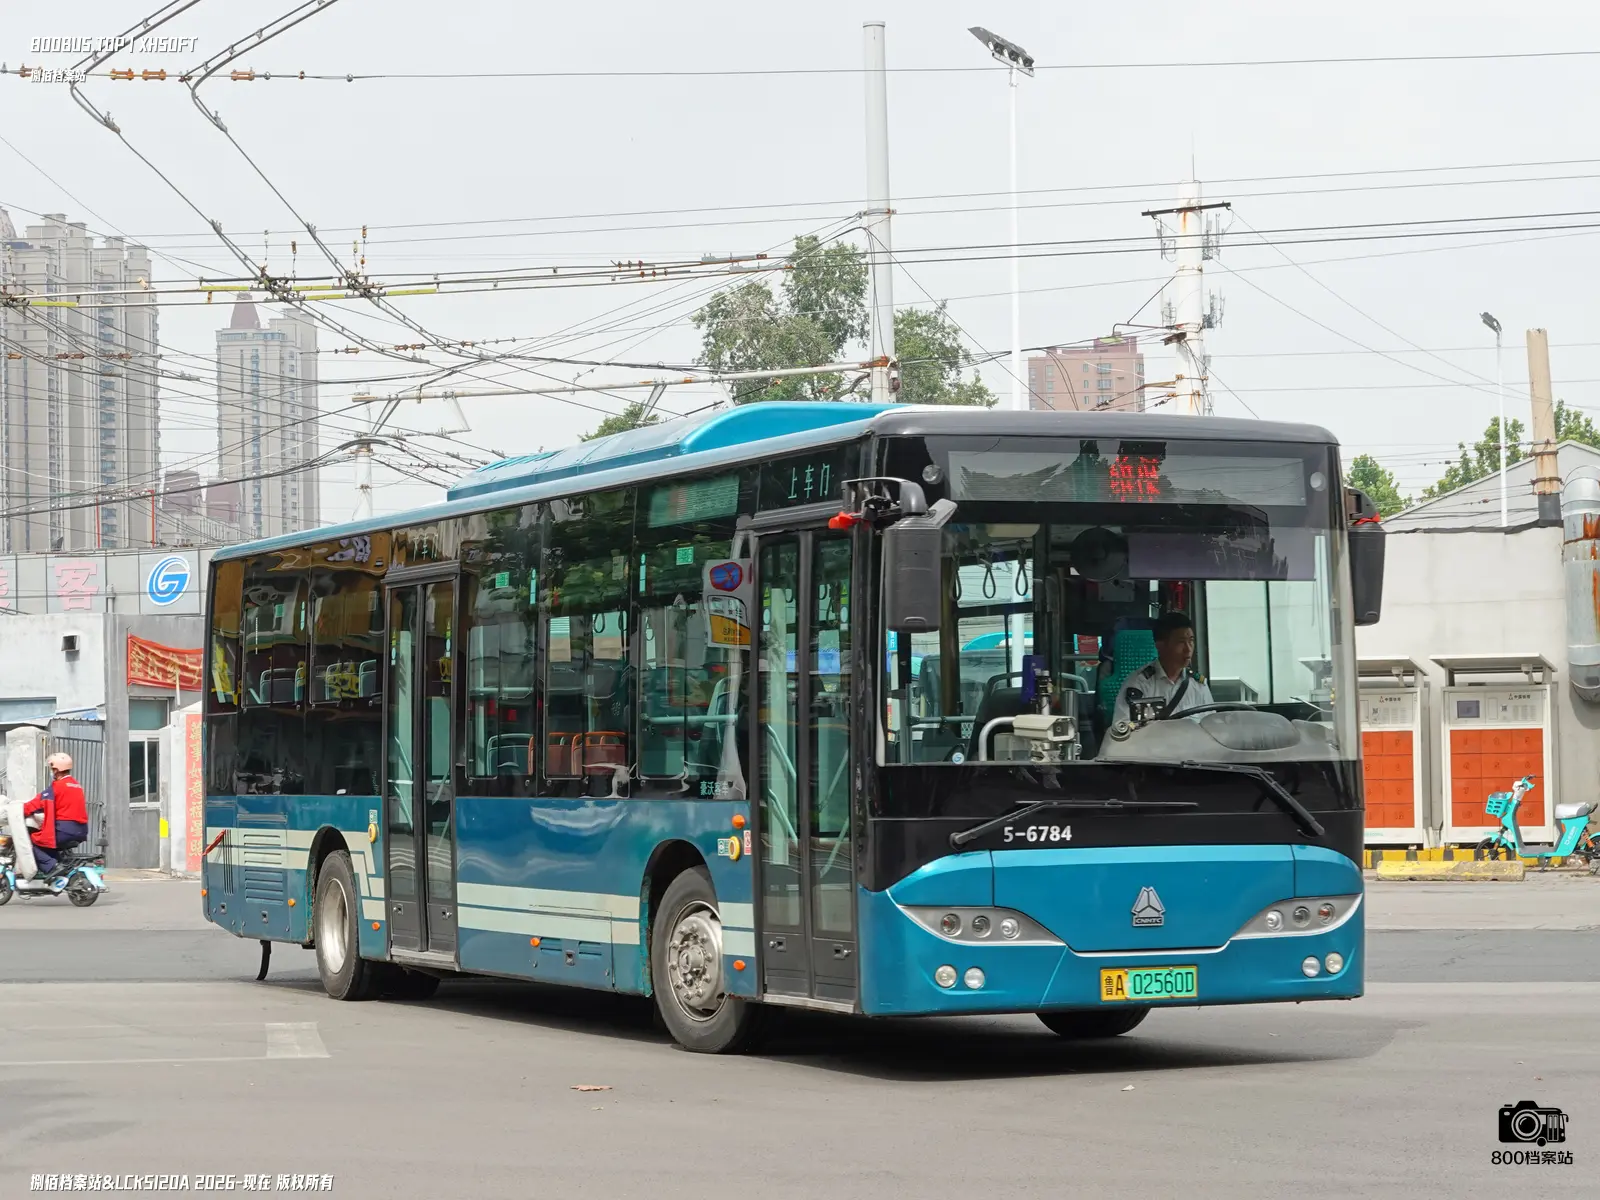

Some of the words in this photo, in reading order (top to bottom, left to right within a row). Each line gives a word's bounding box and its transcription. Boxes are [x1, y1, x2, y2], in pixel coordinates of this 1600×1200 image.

[787, 463, 831, 499] 上车门
[700, 780, 729, 796] 豪沃客车
[1003, 825, 1073, 843] 5-6784
